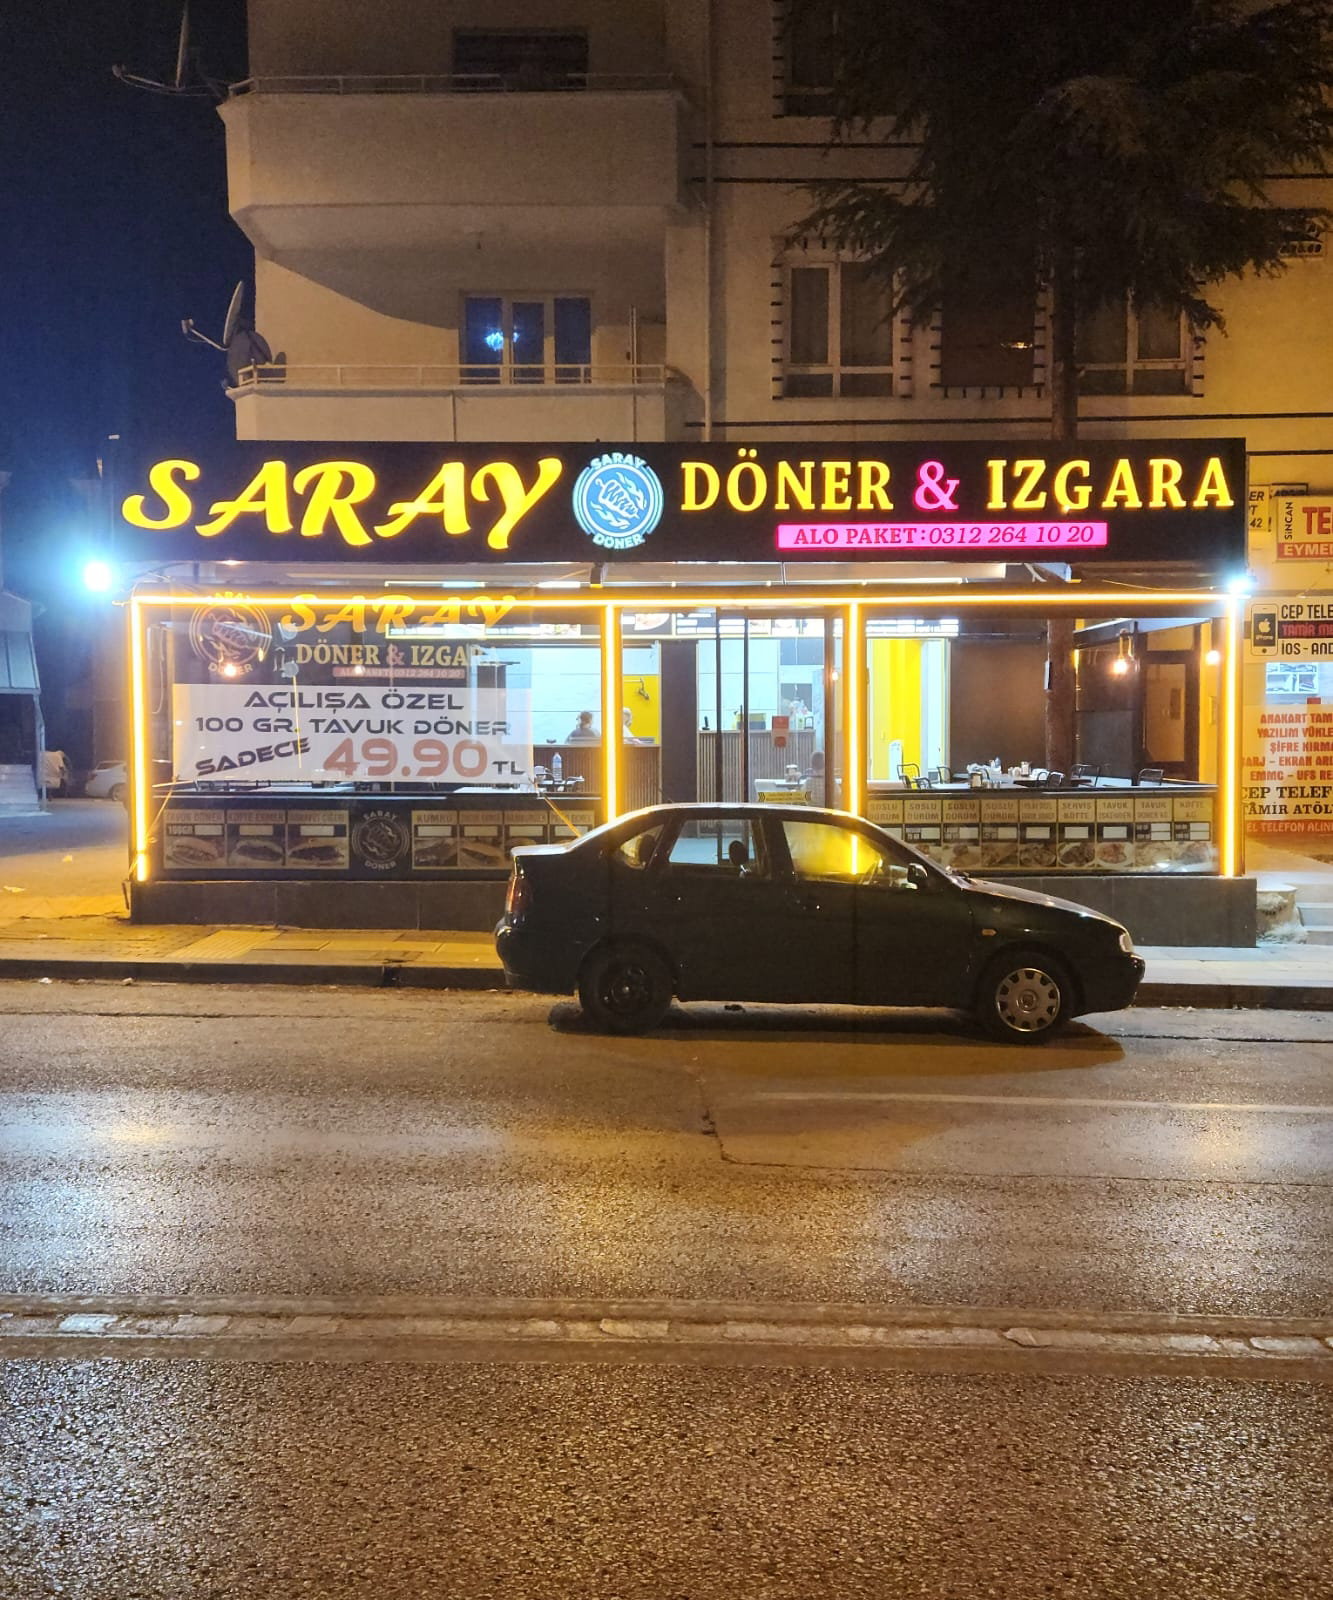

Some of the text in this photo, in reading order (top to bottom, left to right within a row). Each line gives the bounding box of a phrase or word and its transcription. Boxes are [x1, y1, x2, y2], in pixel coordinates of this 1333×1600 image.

[590, 452, 647, 469] SARAY
[680, 447, 1234, 514] DÖNER & IZGARA
[121, 457, 563, 550] SARAY
[1302, 506, 1333, 535] TE
[793, 528, 839, 545] ALO
[988, 526, 1027, 543] 264
[1035, 526, 1061, 542] 10
[1067, 525, 1094, 543] 20
[281, 593, 516, 634] SARAY
[1281, 604, 1304, 619] CEP
[296, 639, 380, 665] DÖNER
[386, 644, 406, 666] &
[244, 688, 464, 714] AÇILIŞA ÖZEL
[195, 717, 243, 732] 100
[309, 718, 404, 735] TAVUK
[413, 716, 511, 735] DÖNER
[1257, 727, 1299, 738] YAZILIM
[195, 737, 311, 776] SADECE
[1270, 741, 1299, 754] ŞİFRE
[322, 738, 525, 778] 49.90 TL
[1241, 756, 1266, 767] ARJ
[1279, 756, 1313, 766] EKRAN
[1250, 770, 1284, 781] EMMC
[1296, 769, 1317, 781] UFS
[1275, 785, 1333, 799] TELEF
[1292, 801, 1333, 815] ATÖL
[1260, 822, 1305, 833] TELEFON
